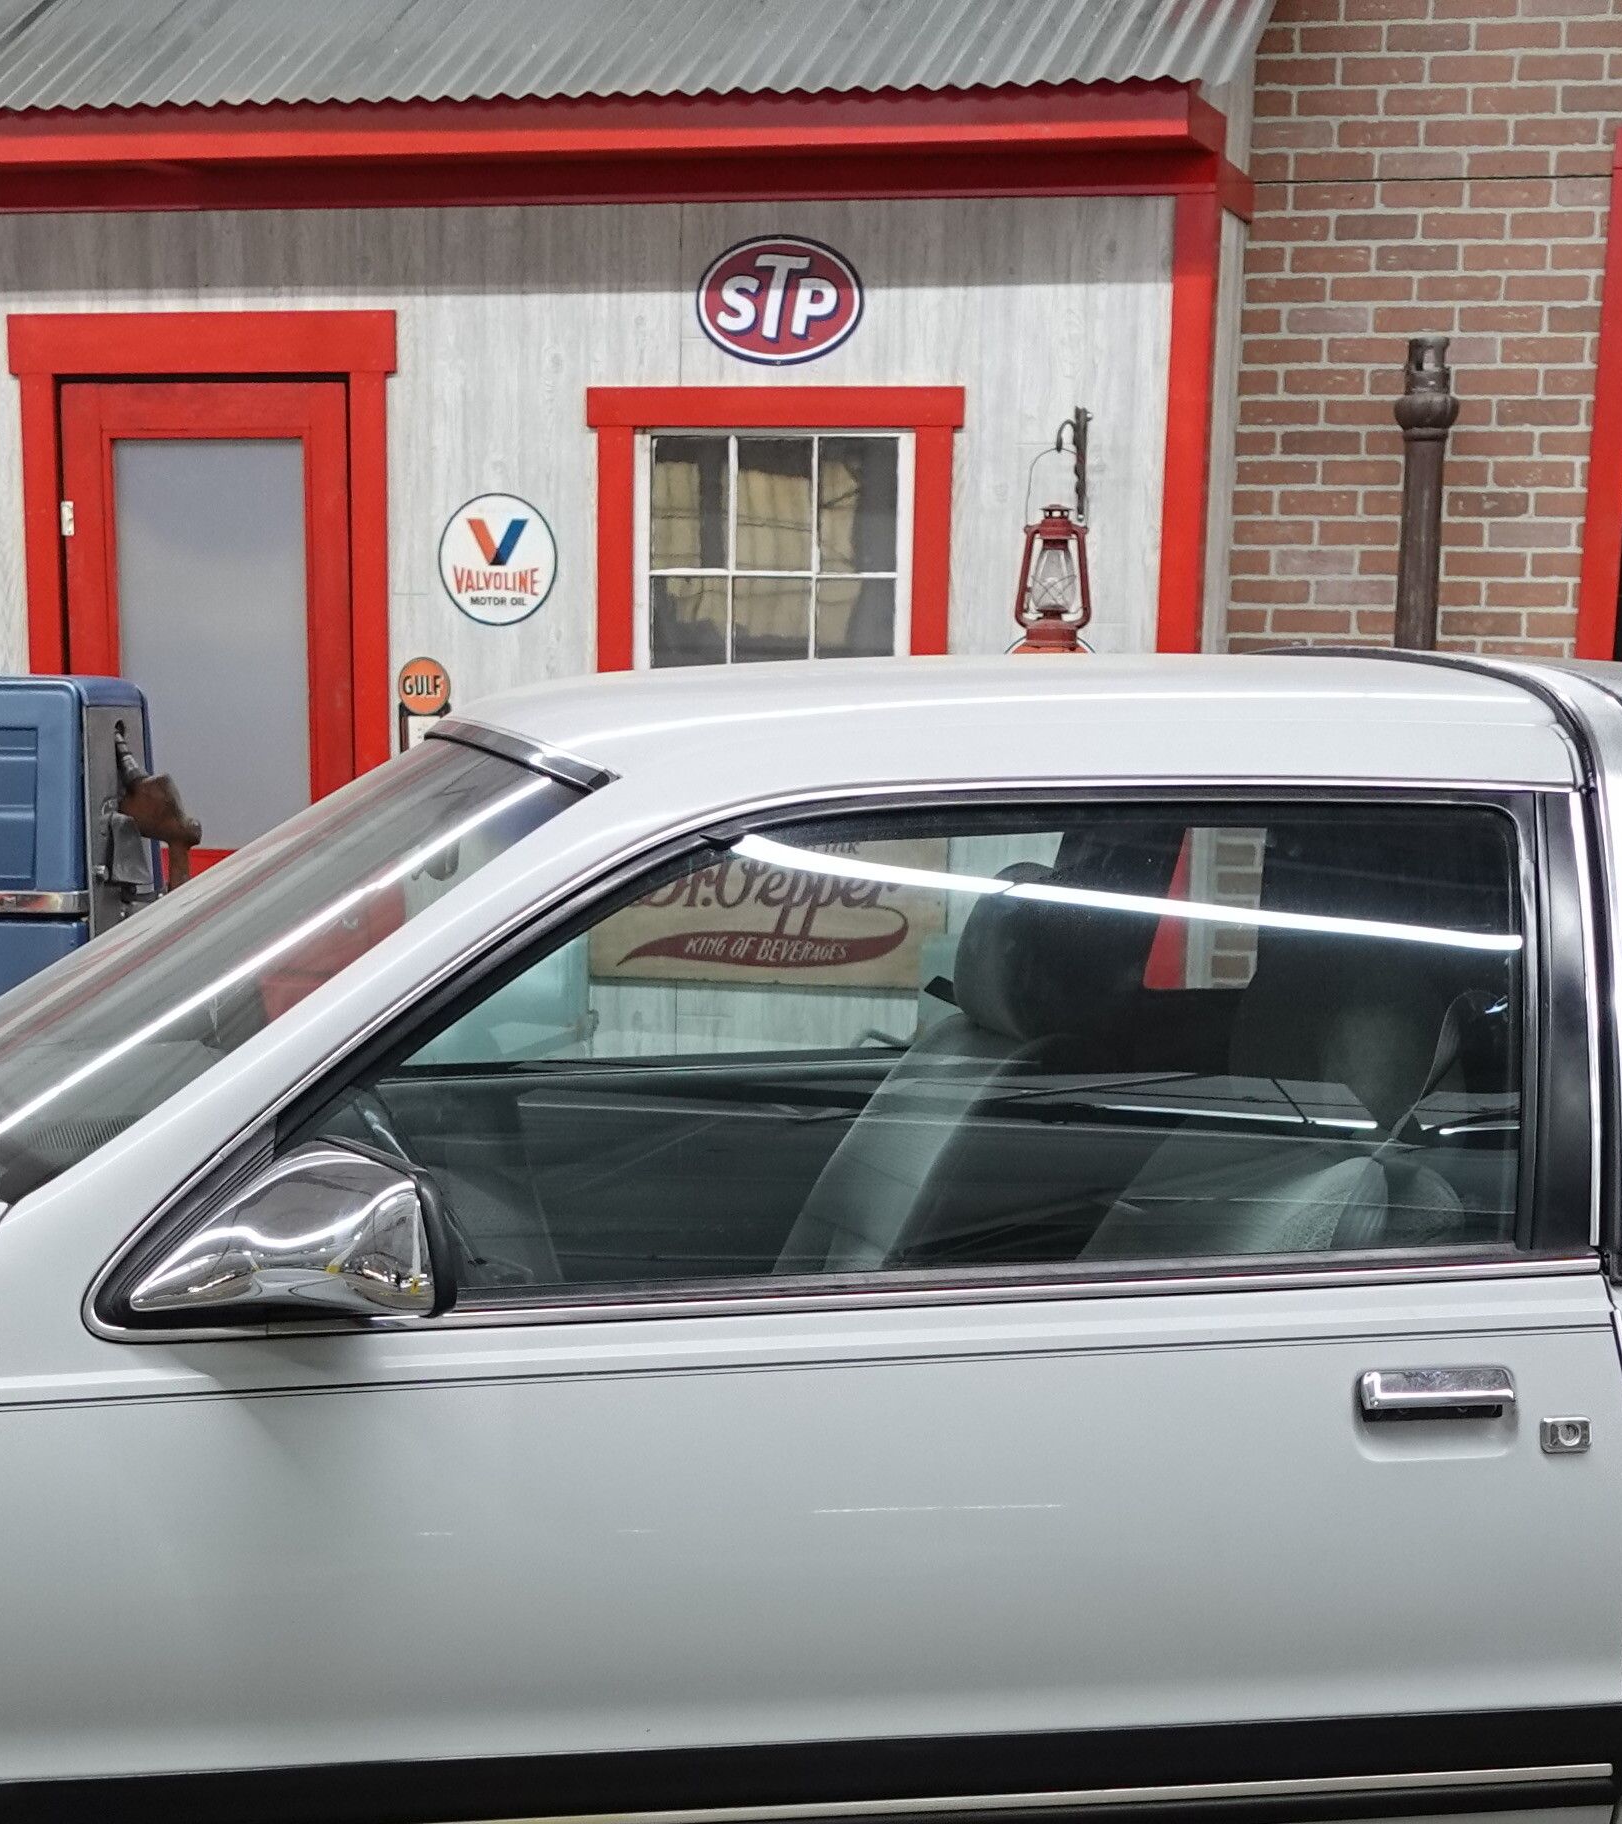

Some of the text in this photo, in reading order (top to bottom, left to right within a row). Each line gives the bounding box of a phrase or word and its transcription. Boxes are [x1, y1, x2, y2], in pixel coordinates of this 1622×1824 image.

[716, 253, 838, 340] STP
[453, 564, 540, 597] VALVOLINE
[470, 596, 527, 606] MOTOR OIL
[402, 674, 442, 696] GULF
[684, 936, 848, 962] KING OF BEVERAGES
